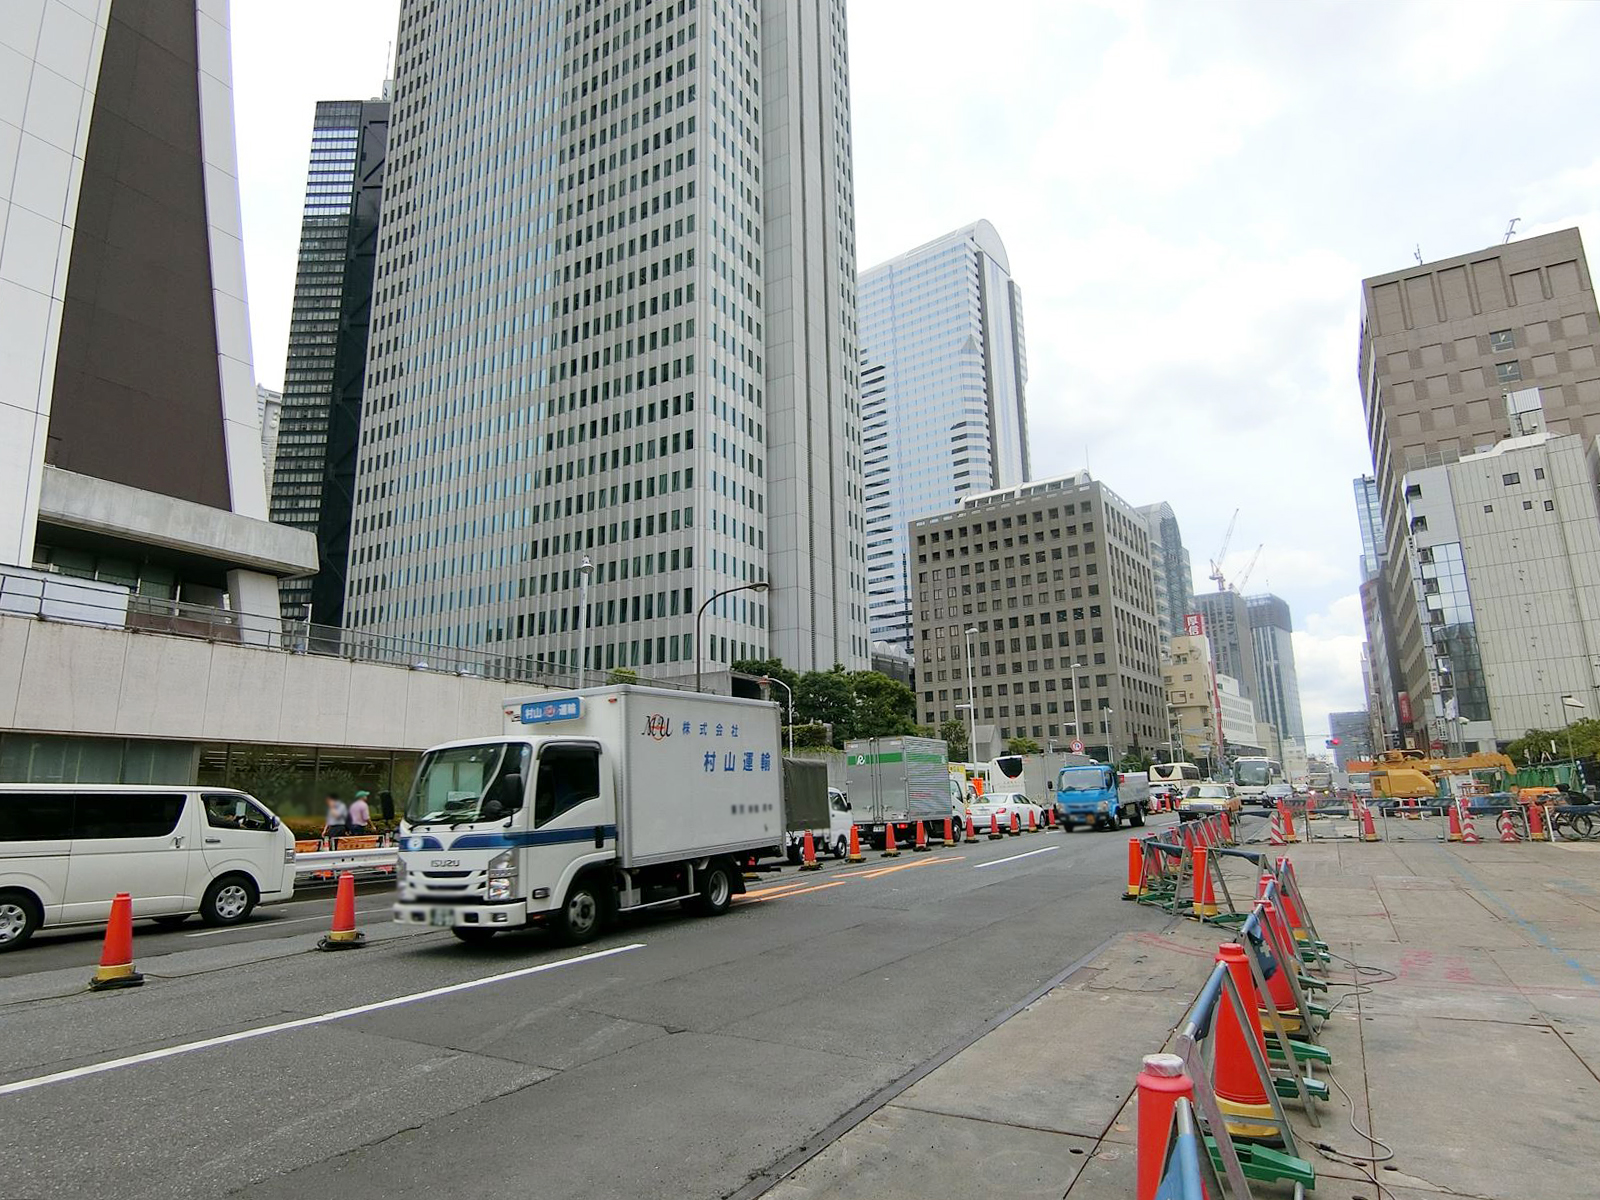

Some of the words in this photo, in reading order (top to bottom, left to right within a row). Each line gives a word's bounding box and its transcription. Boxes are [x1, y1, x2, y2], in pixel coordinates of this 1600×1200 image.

[525, 707, 542, 719] 村山
[682, 721, 739, 738] 株式会社
[703, 751, 771, 772] 村山運輸
[431, 859, 461, 867] ISUZU
